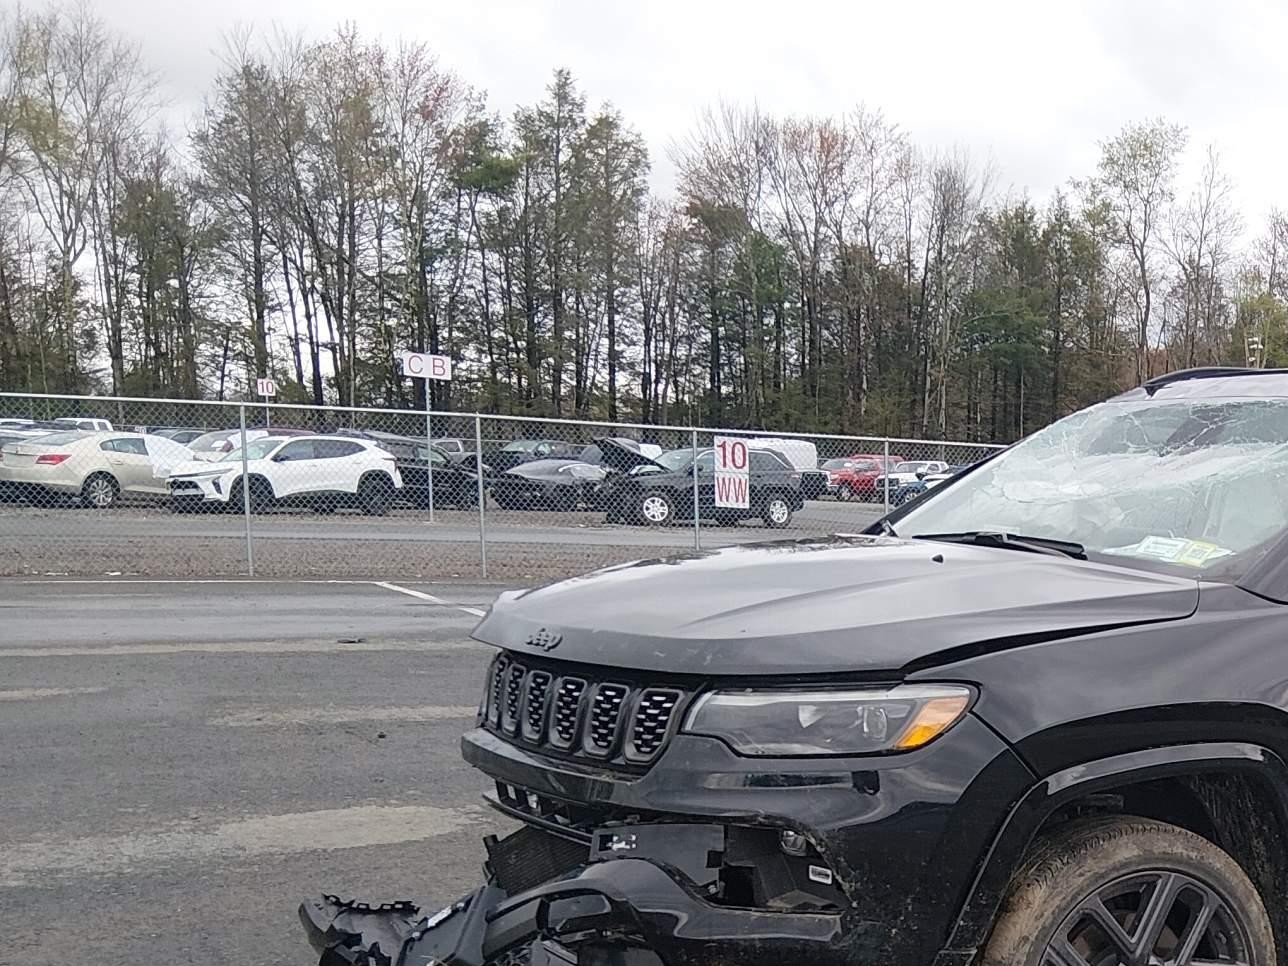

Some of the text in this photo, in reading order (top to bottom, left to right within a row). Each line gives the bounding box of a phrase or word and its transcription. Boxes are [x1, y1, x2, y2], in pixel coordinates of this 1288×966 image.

[408, 354, 446, 376] C B
[259, 381, 274, 394] 10
[716, 440, 747, 469] 10
[716, 477, 748, 503] WW
